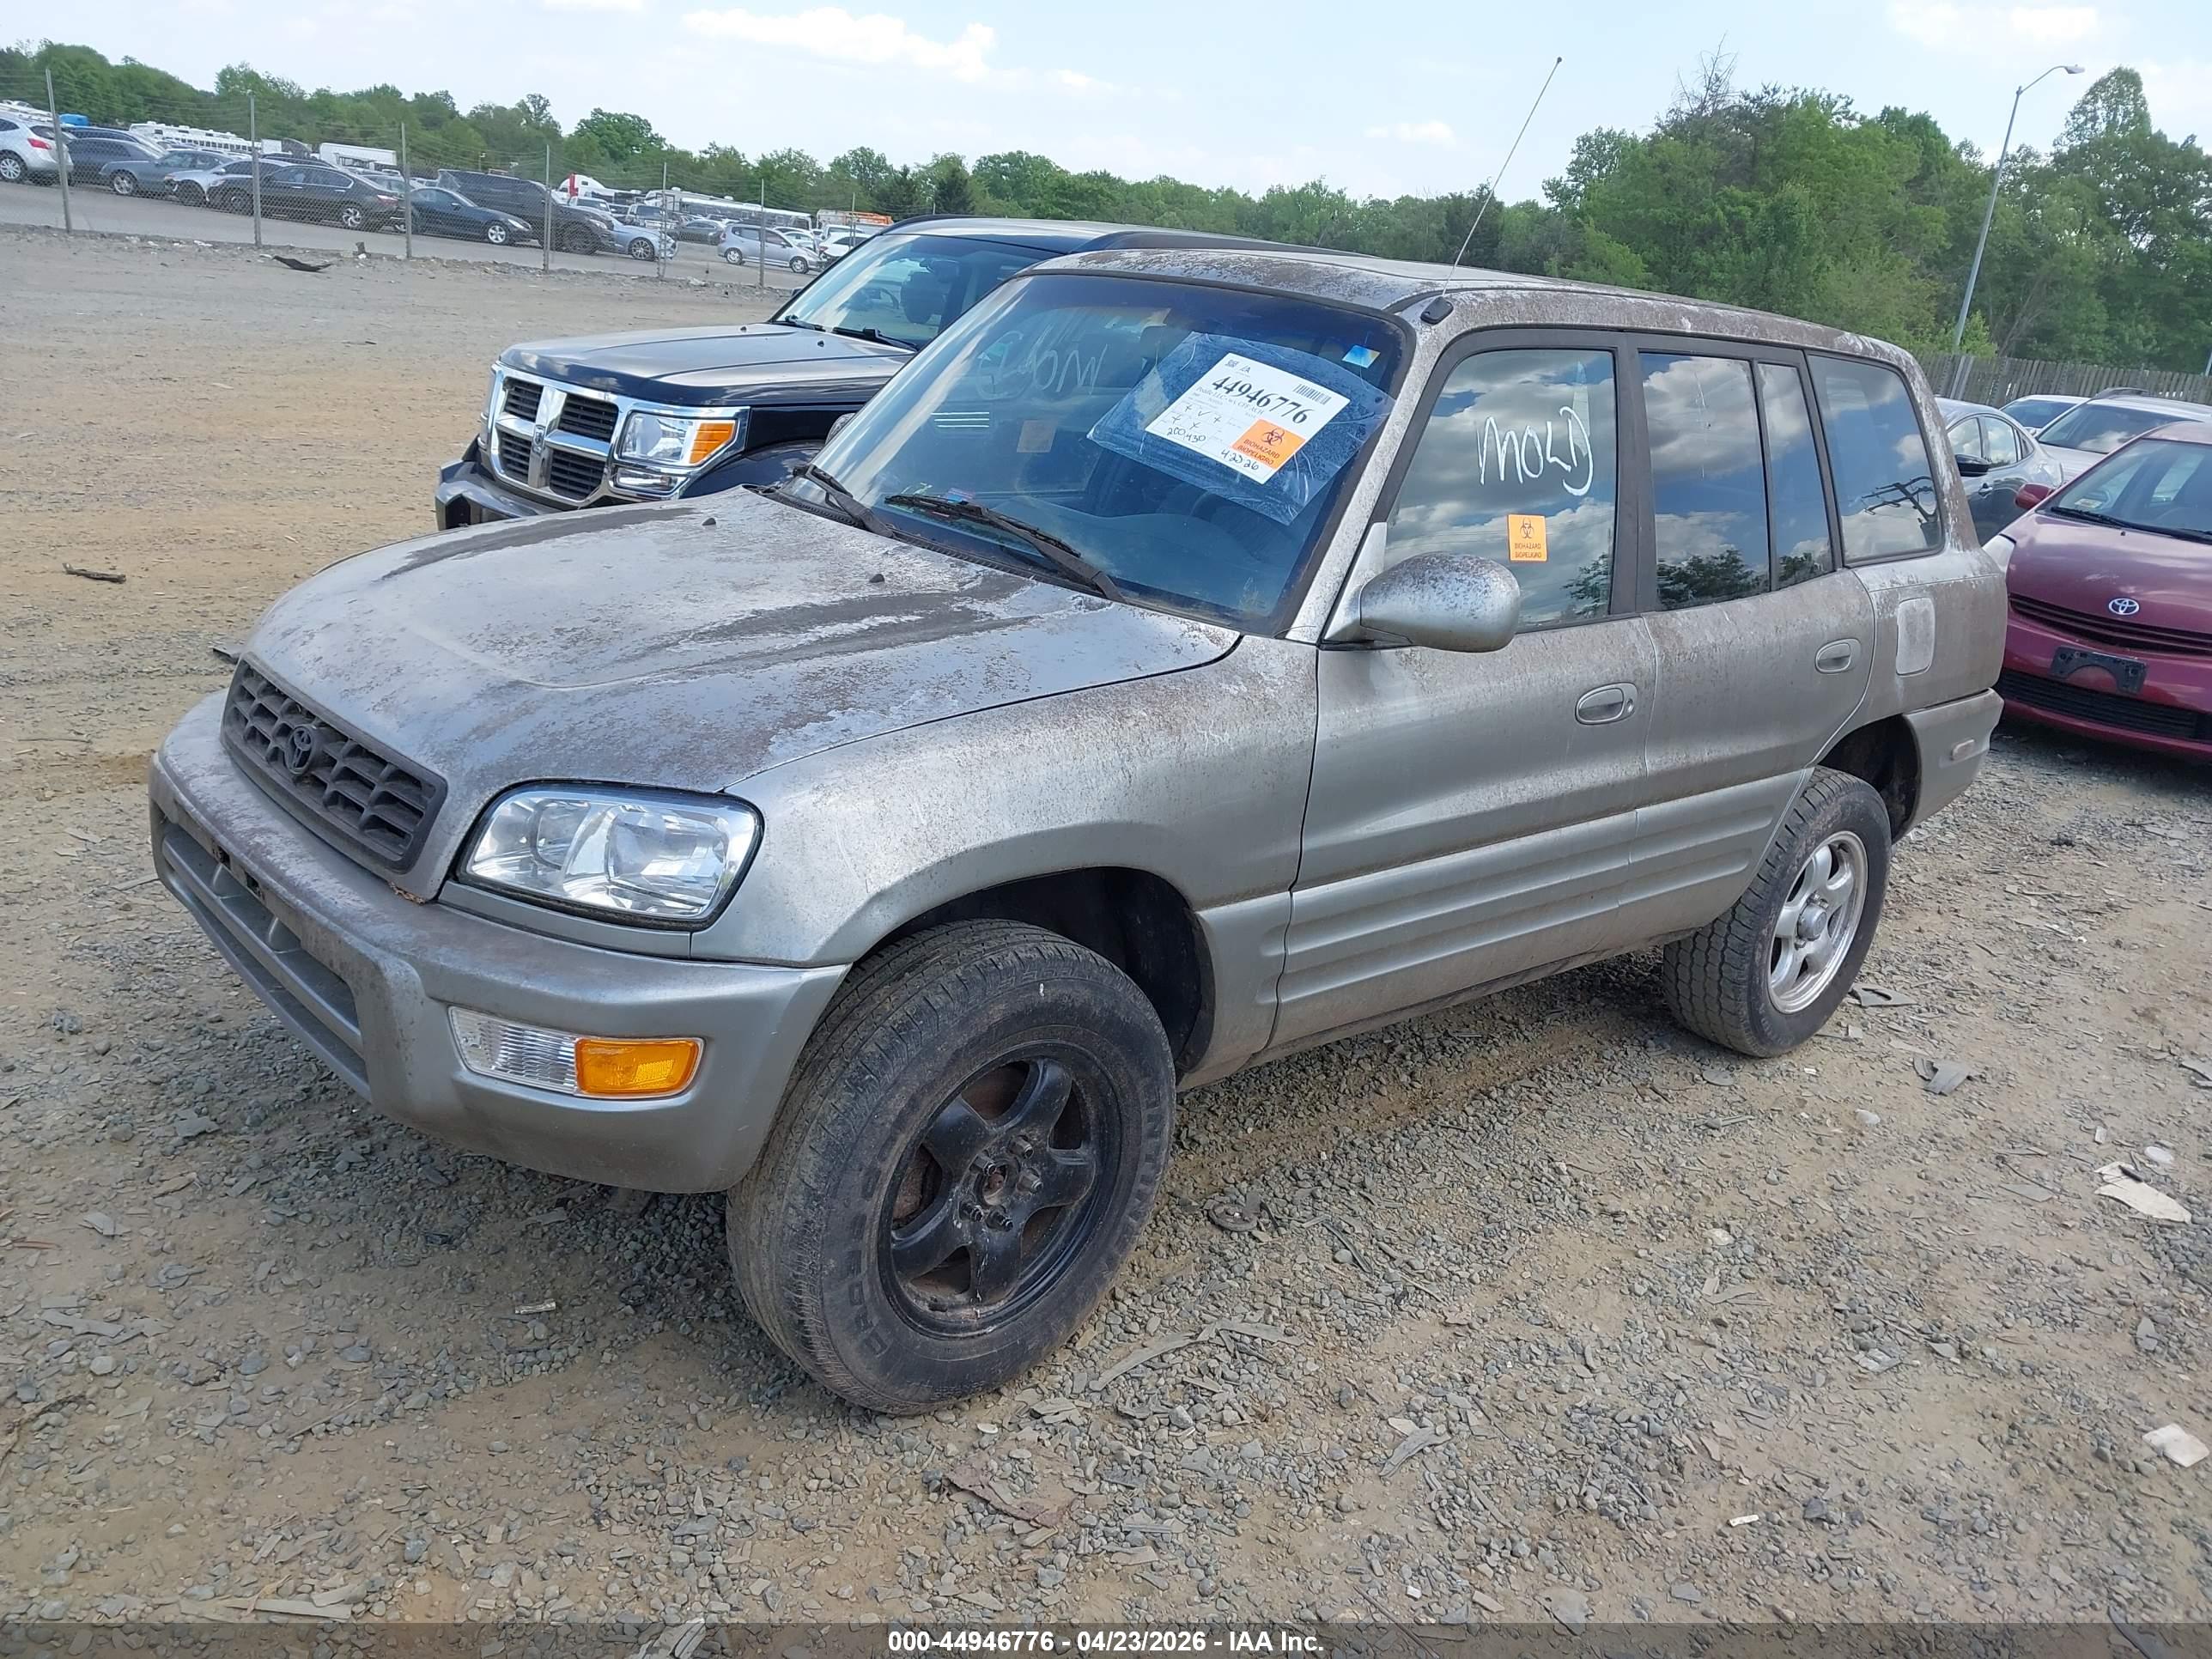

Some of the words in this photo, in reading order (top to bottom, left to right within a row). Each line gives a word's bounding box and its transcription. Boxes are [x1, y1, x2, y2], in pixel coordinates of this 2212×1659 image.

[1212, 376, 1315, 424] 44946776
[1237, 445, 1274, 465] BIOPELIGRO
[1243, 439, 1280, 459] BIOHAZARD
[1476, 405, 1594, 496] MOLD
